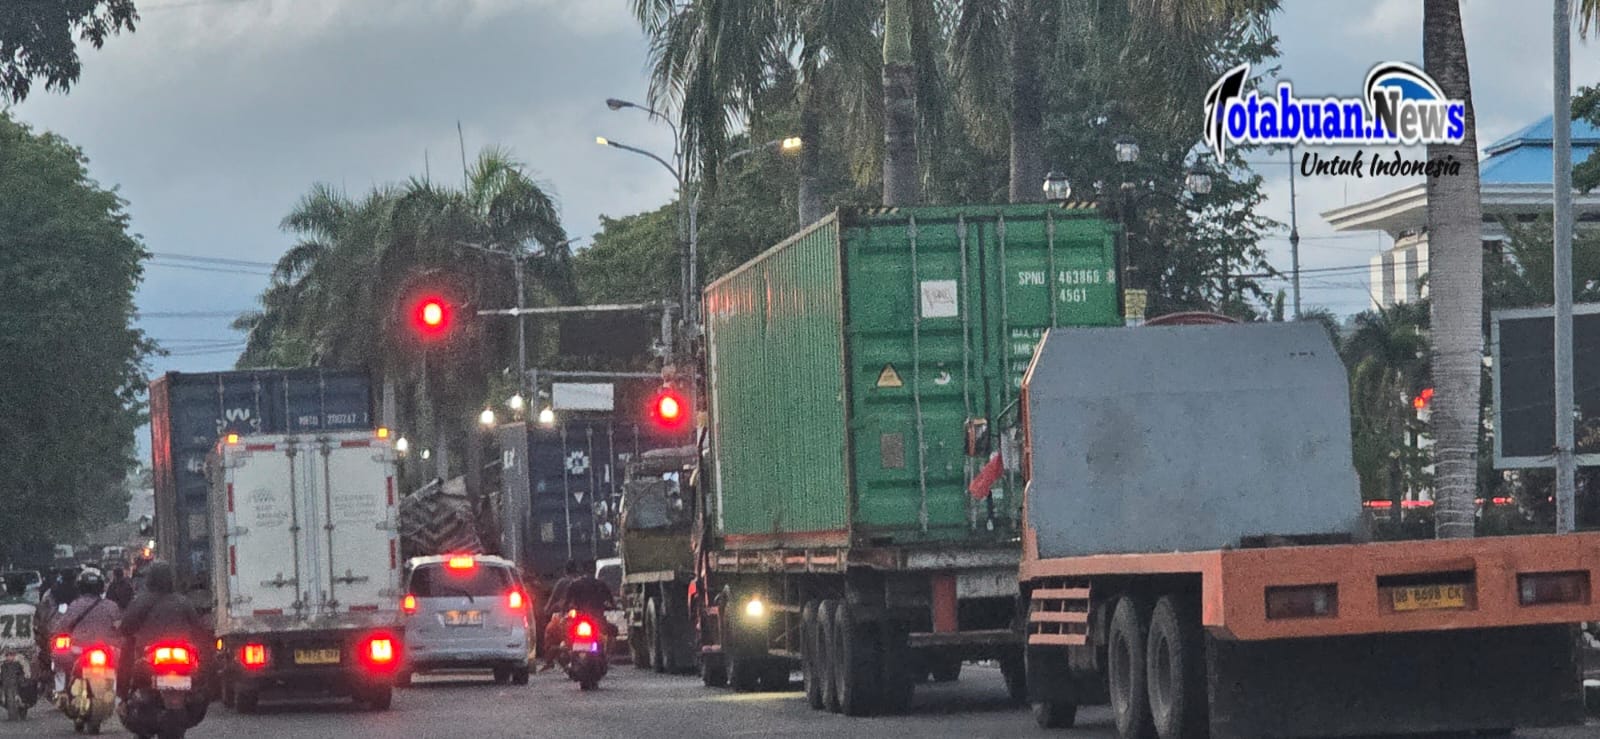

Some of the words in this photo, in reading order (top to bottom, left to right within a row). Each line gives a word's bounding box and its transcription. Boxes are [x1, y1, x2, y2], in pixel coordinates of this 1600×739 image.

[1018, 271, 1046, 285] SPNU
[1059, 288, 1087, 302] 45G1
[1448, 586, 1461, 600] CK
